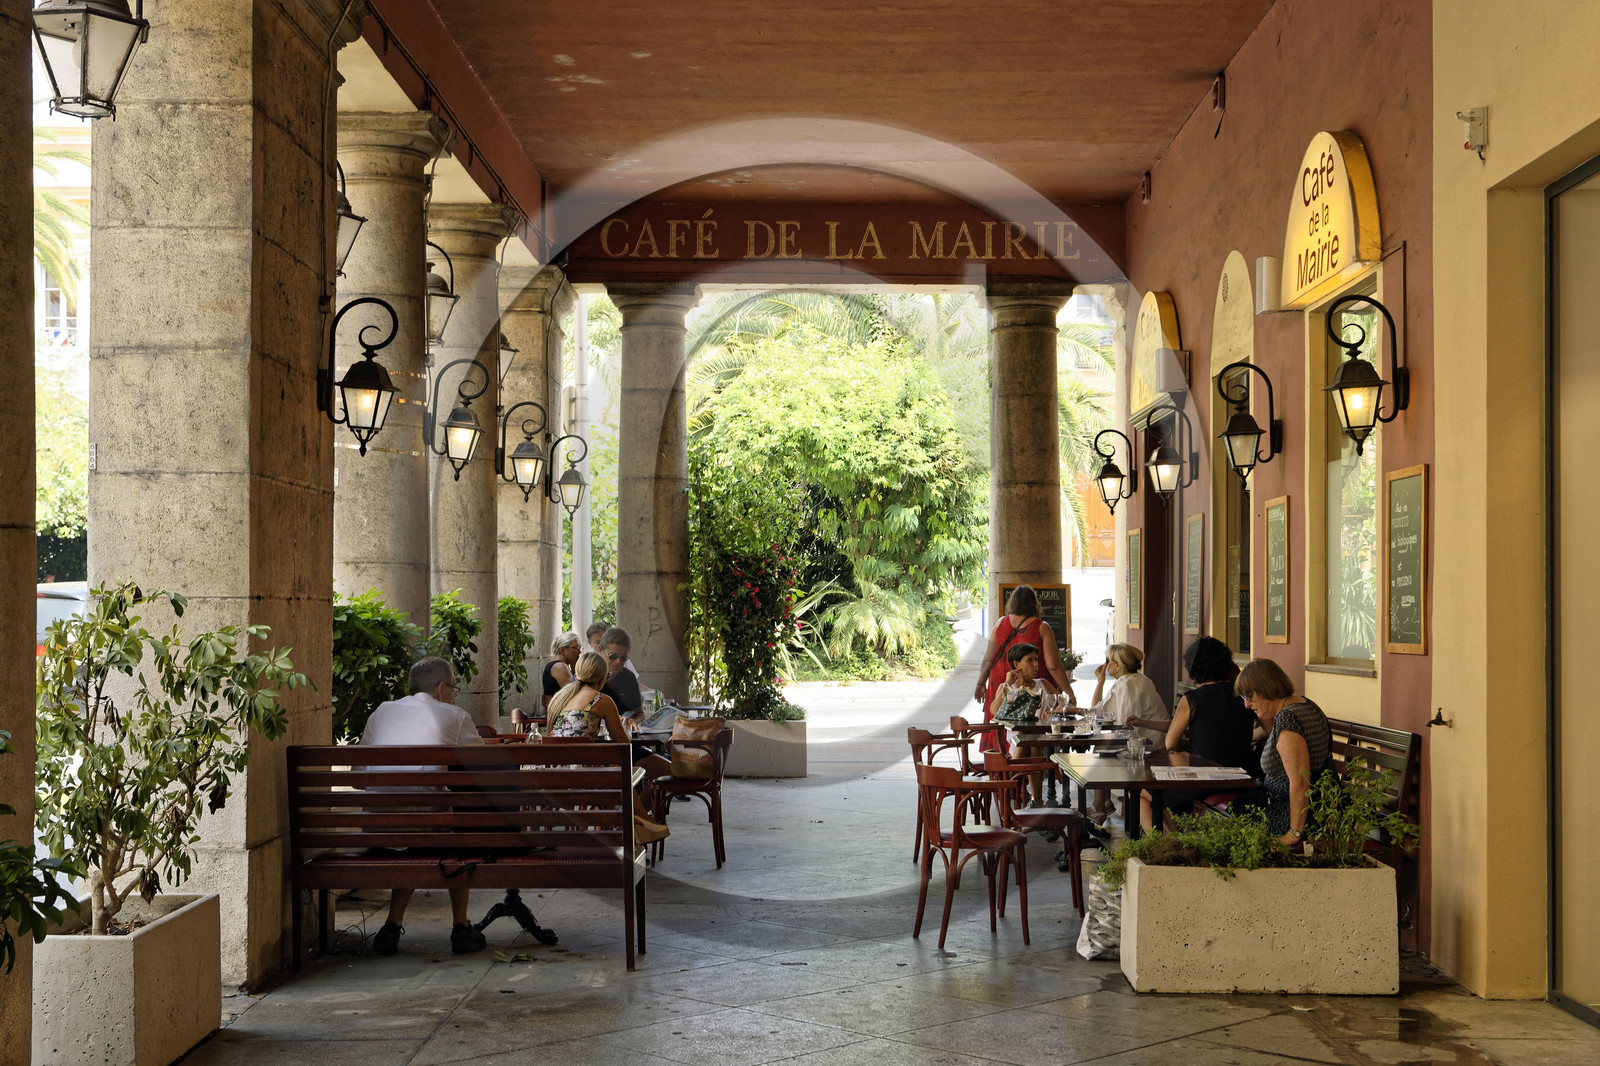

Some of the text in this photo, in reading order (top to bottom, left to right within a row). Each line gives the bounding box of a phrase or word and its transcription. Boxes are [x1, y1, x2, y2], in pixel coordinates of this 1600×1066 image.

[1302, 144, 1335, 207] Café
[600, 208, 1080, 260] CAFÉ DE LA MAIRIE
[1308, 203, 1330, 237] de la
[1296, 230, 1340, 292] Mairie
